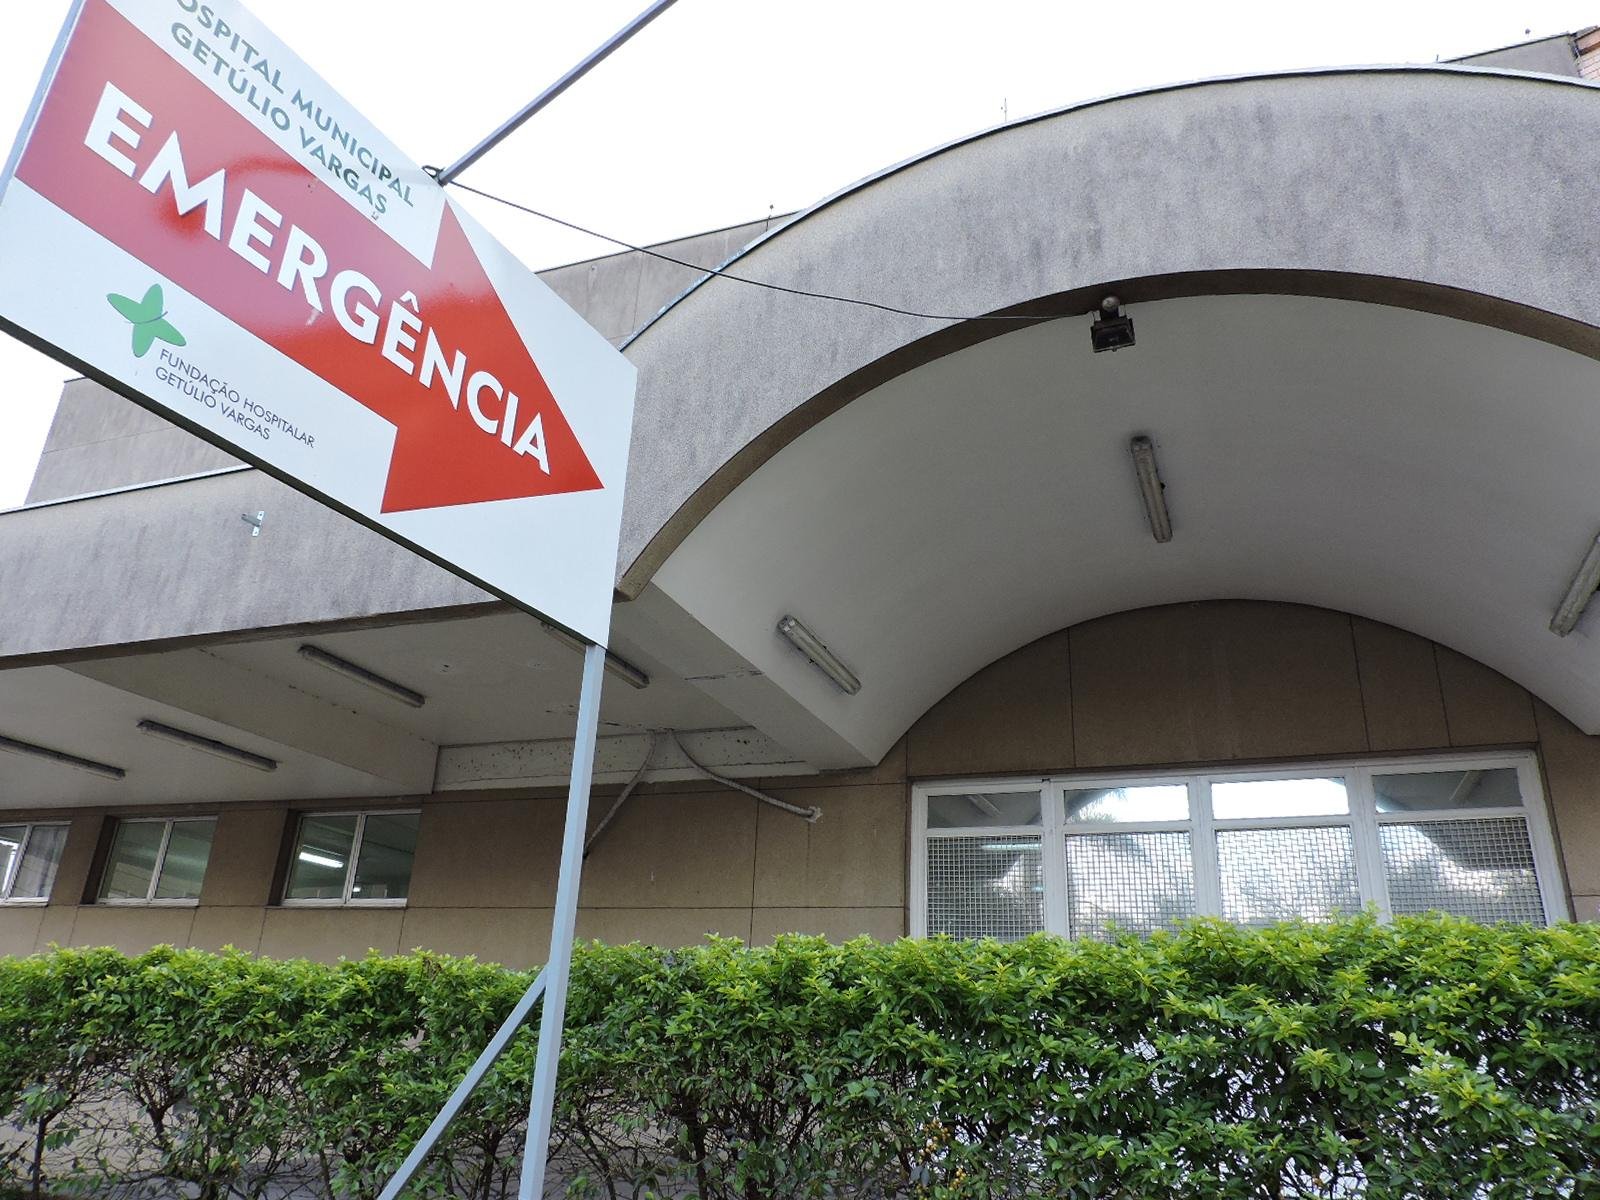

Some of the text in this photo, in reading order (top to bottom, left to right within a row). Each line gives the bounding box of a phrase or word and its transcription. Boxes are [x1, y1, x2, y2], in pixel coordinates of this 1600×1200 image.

[171, 22, 387, 214] GETÚLIO VARGAS
[291, 89, 413, 207] MUNICIPAL
[84, 81, 551, 475] EMERGÊNCIA
[155, 366, 270, 440] GETÚLIO VARGAS
[160, 349, 315, 448] FUNDAÇÃO HOSPITALAR
